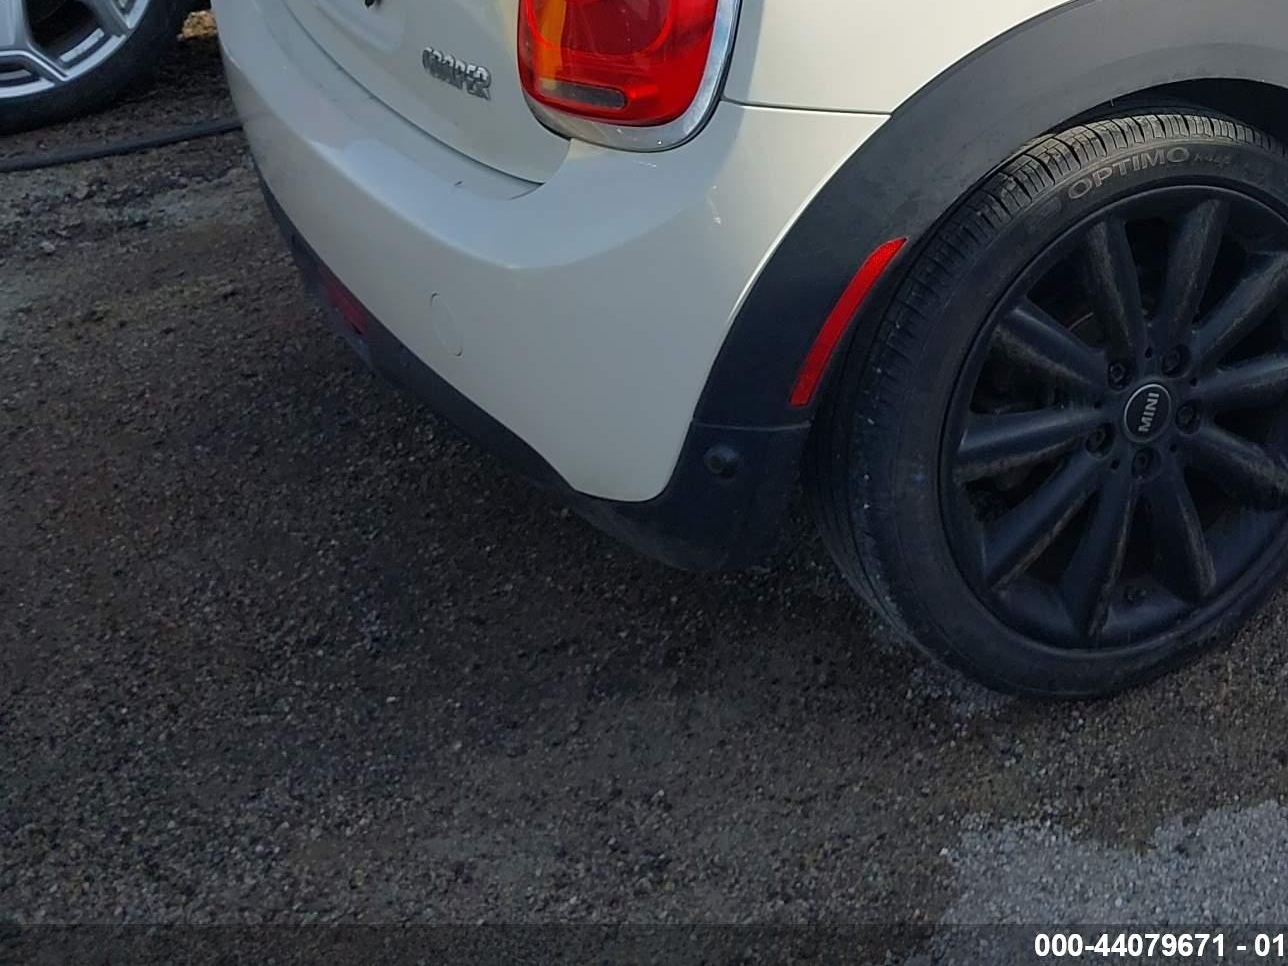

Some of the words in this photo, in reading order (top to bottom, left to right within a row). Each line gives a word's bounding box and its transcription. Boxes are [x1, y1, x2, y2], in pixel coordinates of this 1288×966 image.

[422, 47, 492, 101] COOPER
[1068, 146, 1190, 200] OPTIMO
[1138, 392, 1160, 432] MINI
